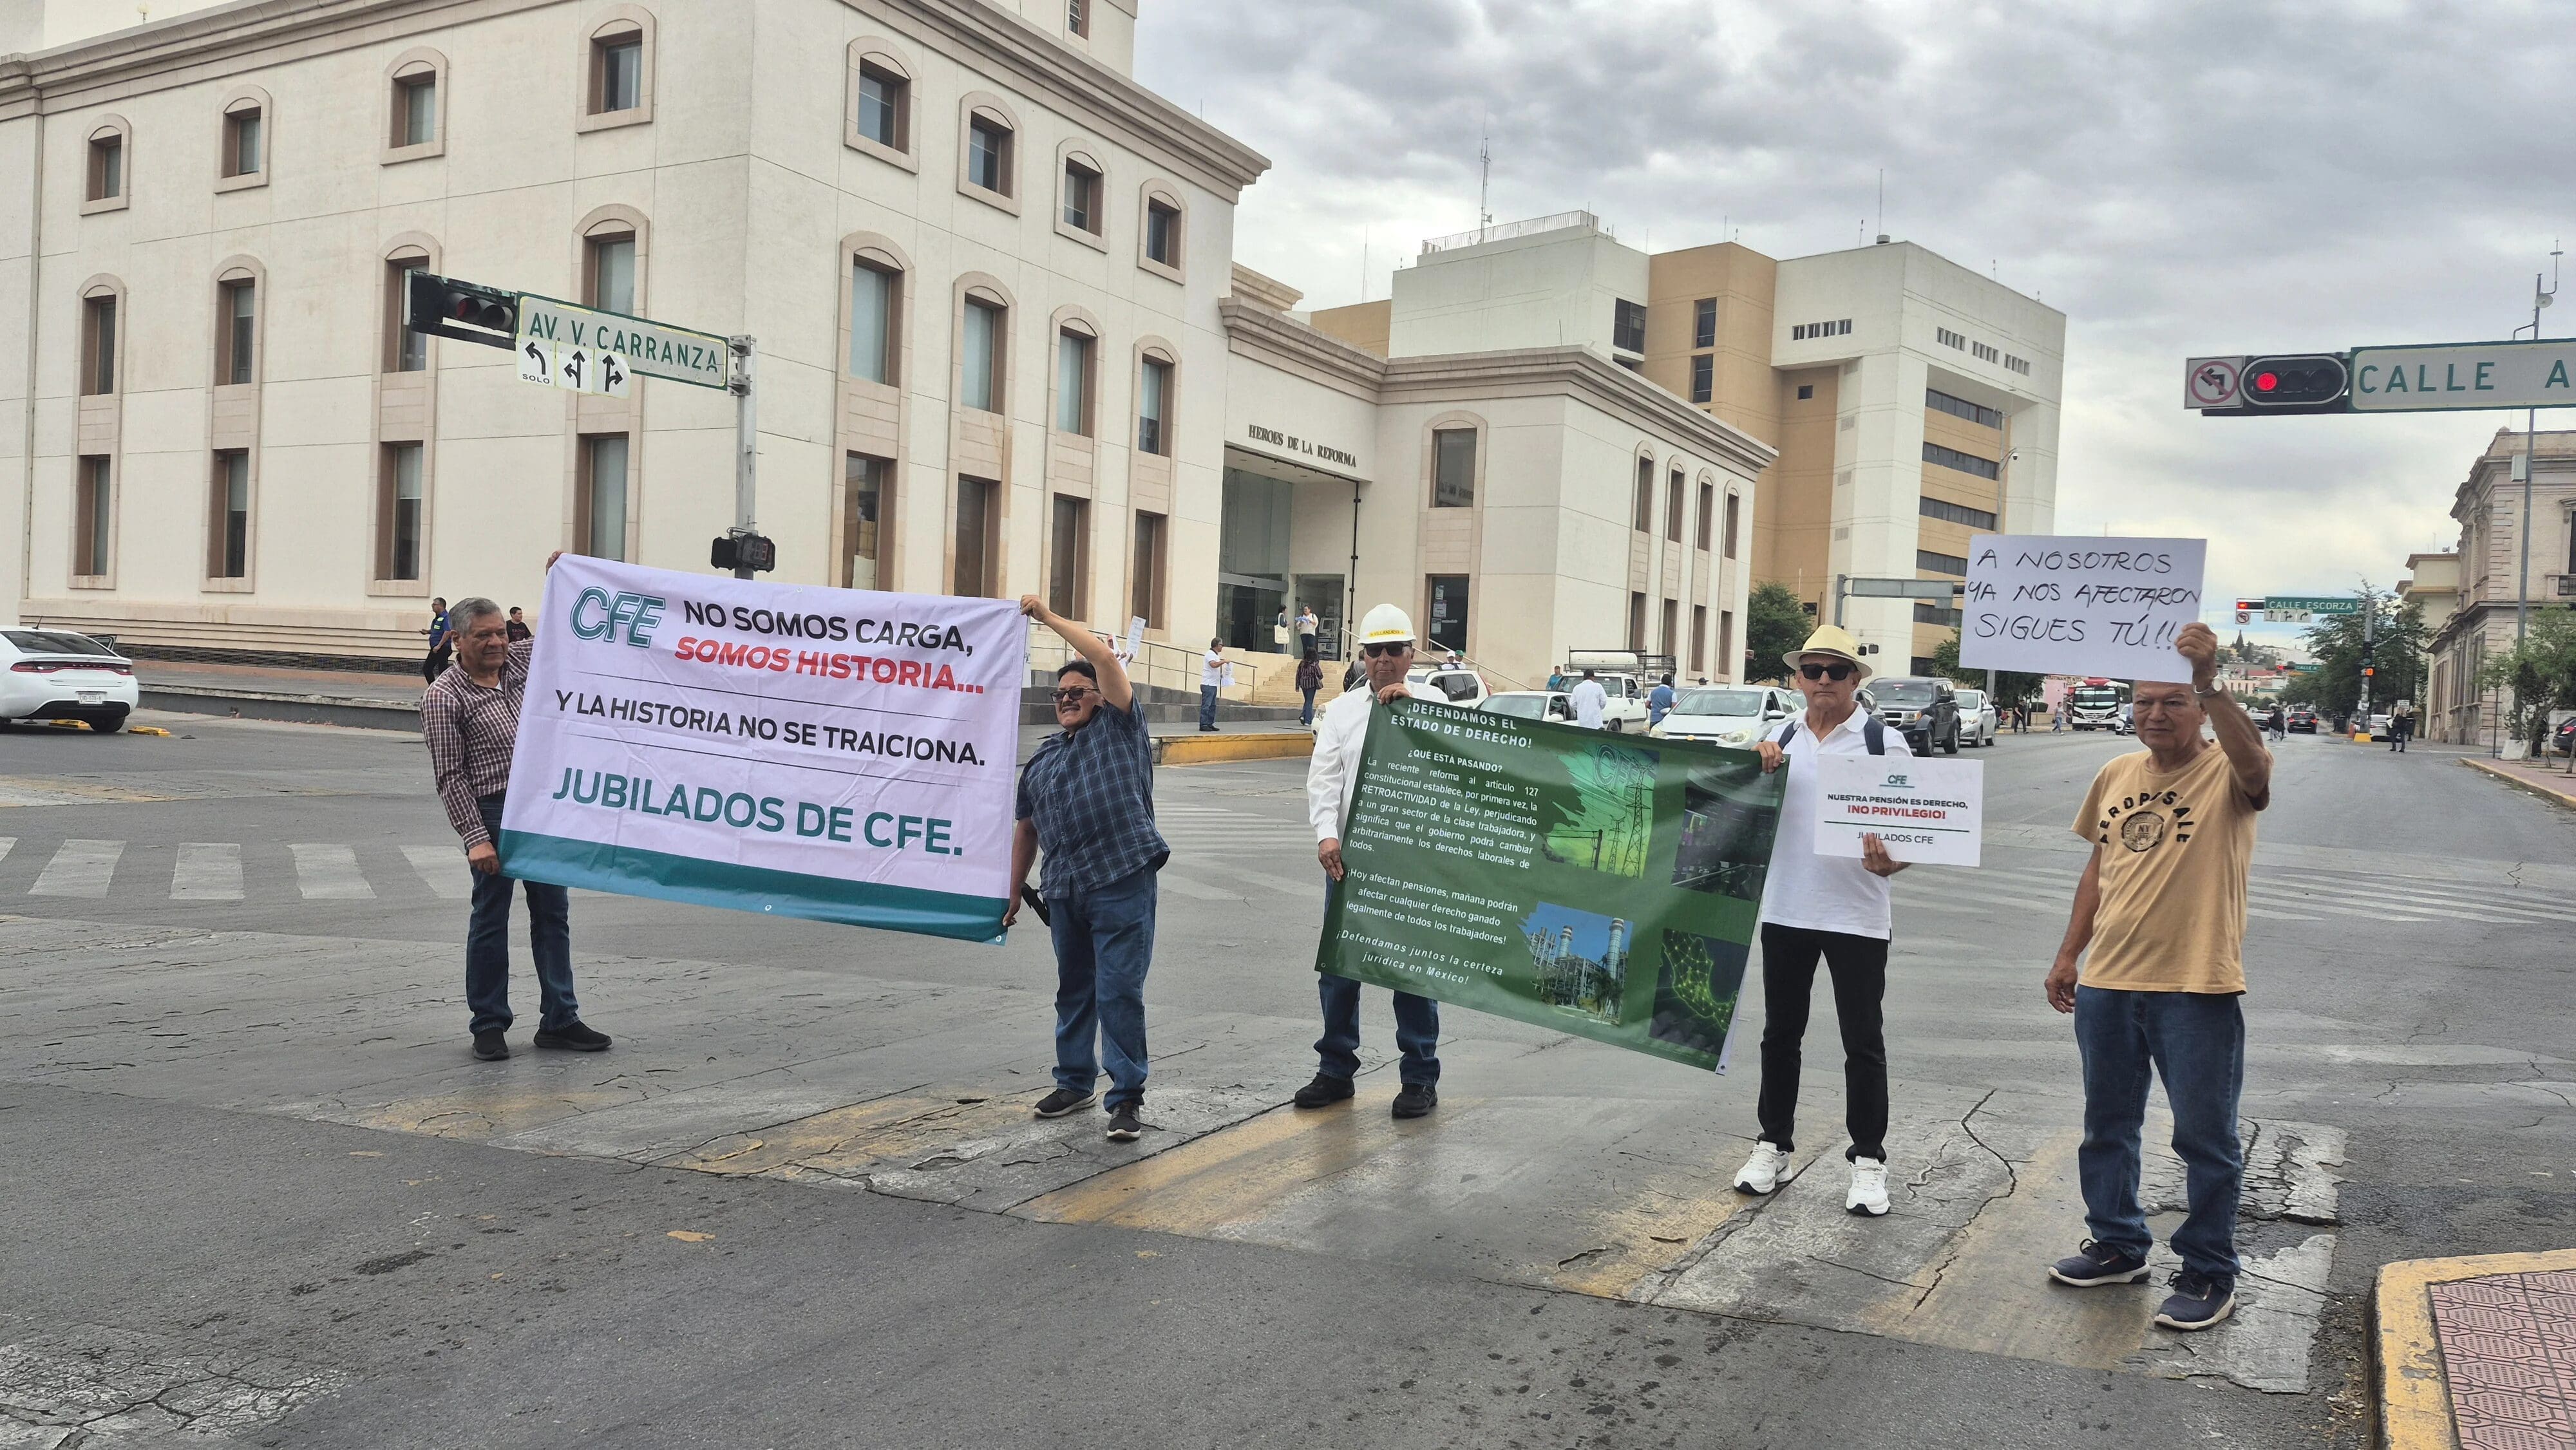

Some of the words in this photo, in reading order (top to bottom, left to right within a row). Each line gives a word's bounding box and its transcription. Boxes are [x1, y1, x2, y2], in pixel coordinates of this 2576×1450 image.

[529, 312, 560, 342] AV.
[571, 320, 586, 346] V.
[596, 326, 718, 373] CARRANZA
[522, 373, 550, 384] SOLO
[2359, 362, 2495, 393] CALLE
[2544, 359, 2570, 388] A
[1249, 424, 1283, 446] HEROES
[1287, 437, 1298, 450] DE
[1302, 440, 1312, 455] LA
[1318, 445, 1356, 467] REFORMA
[1977, 549, 1996, 568] A
[2016, 551, 2171, 573] NOSOTROS
[1968, 581, 1996, 603] YA
[2013, 583, 2061, 601] NOS
[2075, 585, 2201, 610] AFECTARON
[570, 586, 666, 648] CFE
[683, 601, 726, 628] NO
[734, 607, 847, 641] SOMOS
[855, 619, 973, 656] CARGA,
[1975, 614, 2086, 642] SIGUES
[674, 636, 790, 672] SOMOS
[797, 652, 984, 694] HISTORIA...
[556, 690, 573, 711] Y
[577, 693, 606, 717] LA
[611, 697, 732, 734] HISTORIA
[739, 717, 777, 740] NO
[783, 722, 815, 746] SE
[822, 727, 985, 766] TRAICIONA.
[1391, 715, 1439, 732] ESTADO
[1444, 724, 1460, 736] DE
[1465, 729, 1531, 748] DERECHO!
[1407, 703, 1496, 726] ¡DEFENDAMOS
[1502, 719, 1517, 730] EL
[1367, 757, 1377, 766] La
[1388, 762, 1419, 774] reciente
[1430, 769, 1459, 781] reforma
[1485, 780, 1515, 792] artículo
[1525, 787, 1539, 796] 127
[1408, 749, 1432, 759] ¿QUÉ
[1434, 753, 1455, 764] ESTÁ
[1457, 758, 1502, 773] PASANDO?
[1888, 775, 1908, 784] CFE
[1361, 784, 1437, 805] RETROACTIVIDAD
[1440, 800, 1450, 809] de
[1454, 802, 1461, 811] la
[1464, 804, 1481, 816] Ley,
[1484, 809, 1537, 825] perjudicando
[1364, 772, 1421, 788] constitucional
[1423, 783, 1463, 797] establece,
[1481, 794, 1510, 805] primera
[1513, 800, 1528, 811] vez,
[1531, 802, 1537, 811] la
[1828, 794, 1868, 802] NUESTRA
[1923, 800, 1968, 809] DERECHO,
[553, 767, 784, 832] JUBILADOS
[797, 802, 852, 843] DE
[864, 812, 963, 856] CFE.
[1380, 804, 1398, 813] gran
[1402, 808, 1428, 819] sector
[1430, 813, 1440, 821] de
[1444, 814, 1450, 824] la
[1454, 817, 1475, 828] clase
[1479, 822, 1526, 840] trabajadora,
[1530, 833, 1535, 842] y
[1871, 807, 1946, 819] PRIVILEGIO!
[1350, 839, 1374, 851] todos.
[1352, 827, 1414, 845] arbitrariamente
[1418, 838, 1430, 848] los
[1435, 842, 1473, 857] derechos
[1478, 851, 1515, 866] laborales
[1520, 859, 1530, 869] de
[1356, 813, 1389, 825] significa
[1396, 822, 1410, 830] que
[1416, 824, 1423, 833] el
[1428, 828, 1465, 841] gobierno
[1470, 836, 1494, 847] podrá
[1499, 842, 1533, 854] cambiar
[1857, 832, 1912, 842] JILADOS
[1914, 836, 1933, 844] CFE
[1347, 868, 1367, 881] ¡Hoy
[1369, 873, 1400, 886] afectan
[1402, 881, 1448, 899] pensiones,
[1452, 892, 1485, 905] mañana
[1487, 900, 1517, 912] podrán
[1358, 888, 1387, 900] afectar
[1389, 896, 1430, 910] cualquier
[1432, 903, 1466, 918] derecho
[1468, 913, 1501, 926] ganado
[1346, 901, 1392, 918] legalmente
[1395, 912, 1405, 921] de
[1407, 914, 1432, 927] todos
[1434, 920, 1447, 931] los
[1450, 924, 1506, 945] trabajadores!
[1336, 930, 1406, 952] ¡Defendamos
[1409, 946, 1445, 962] juntos
[1449, 955, 1459, 965] la
[1463, 959, 1502, 975] certeza
[1409, 964, 1422, 973] en
[1426, 966, 1469, 984] México!
